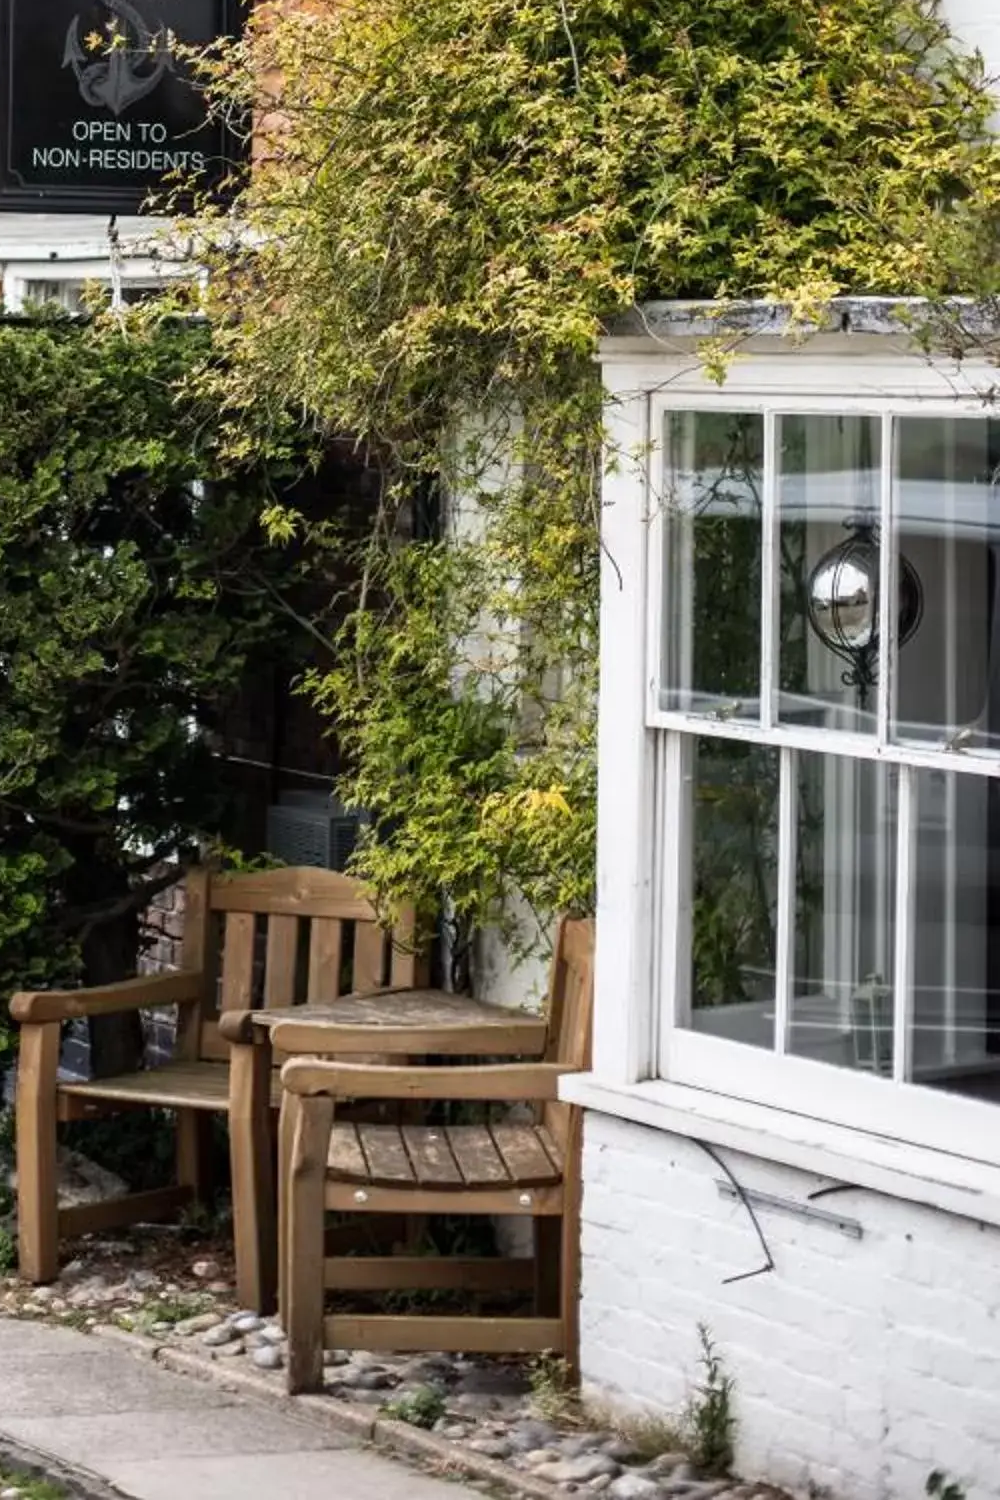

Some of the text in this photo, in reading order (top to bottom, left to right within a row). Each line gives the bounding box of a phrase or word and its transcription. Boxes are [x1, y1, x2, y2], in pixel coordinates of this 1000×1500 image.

[73, 121, 167, 143] OPEN TO
[33, 148, 205, 171] NON-RESIDENTS
